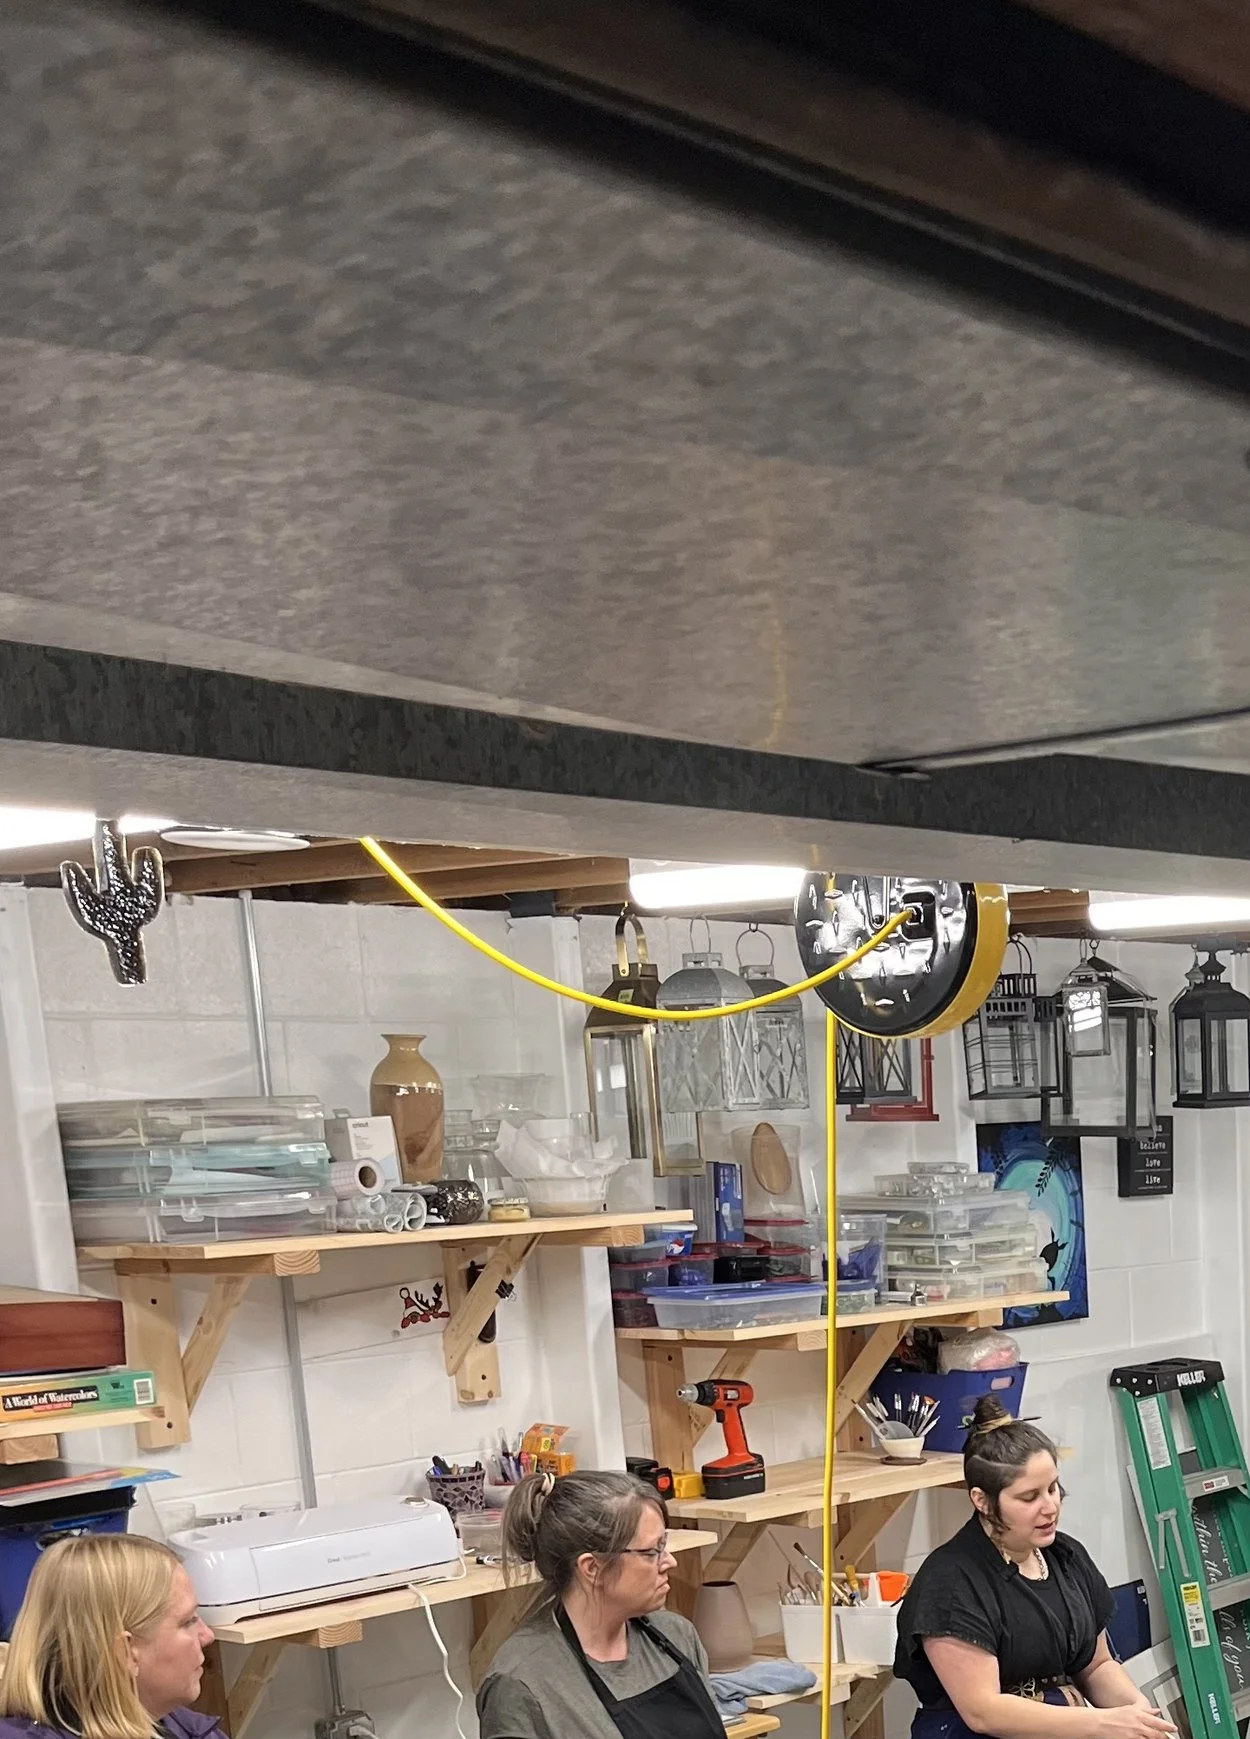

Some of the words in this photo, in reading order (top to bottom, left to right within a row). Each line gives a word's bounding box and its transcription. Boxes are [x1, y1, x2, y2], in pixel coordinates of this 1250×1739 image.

[1177, 1370, 1206, 1387] KELLER
[5, 1397, 13, 1409] A
[13, 1395, 38, 1407] World
[38, 1393, 48, 1405] of
[48, 1389, 98, 1403] Watercolors
[1208, 1693, 1221, 1724] KELLER
